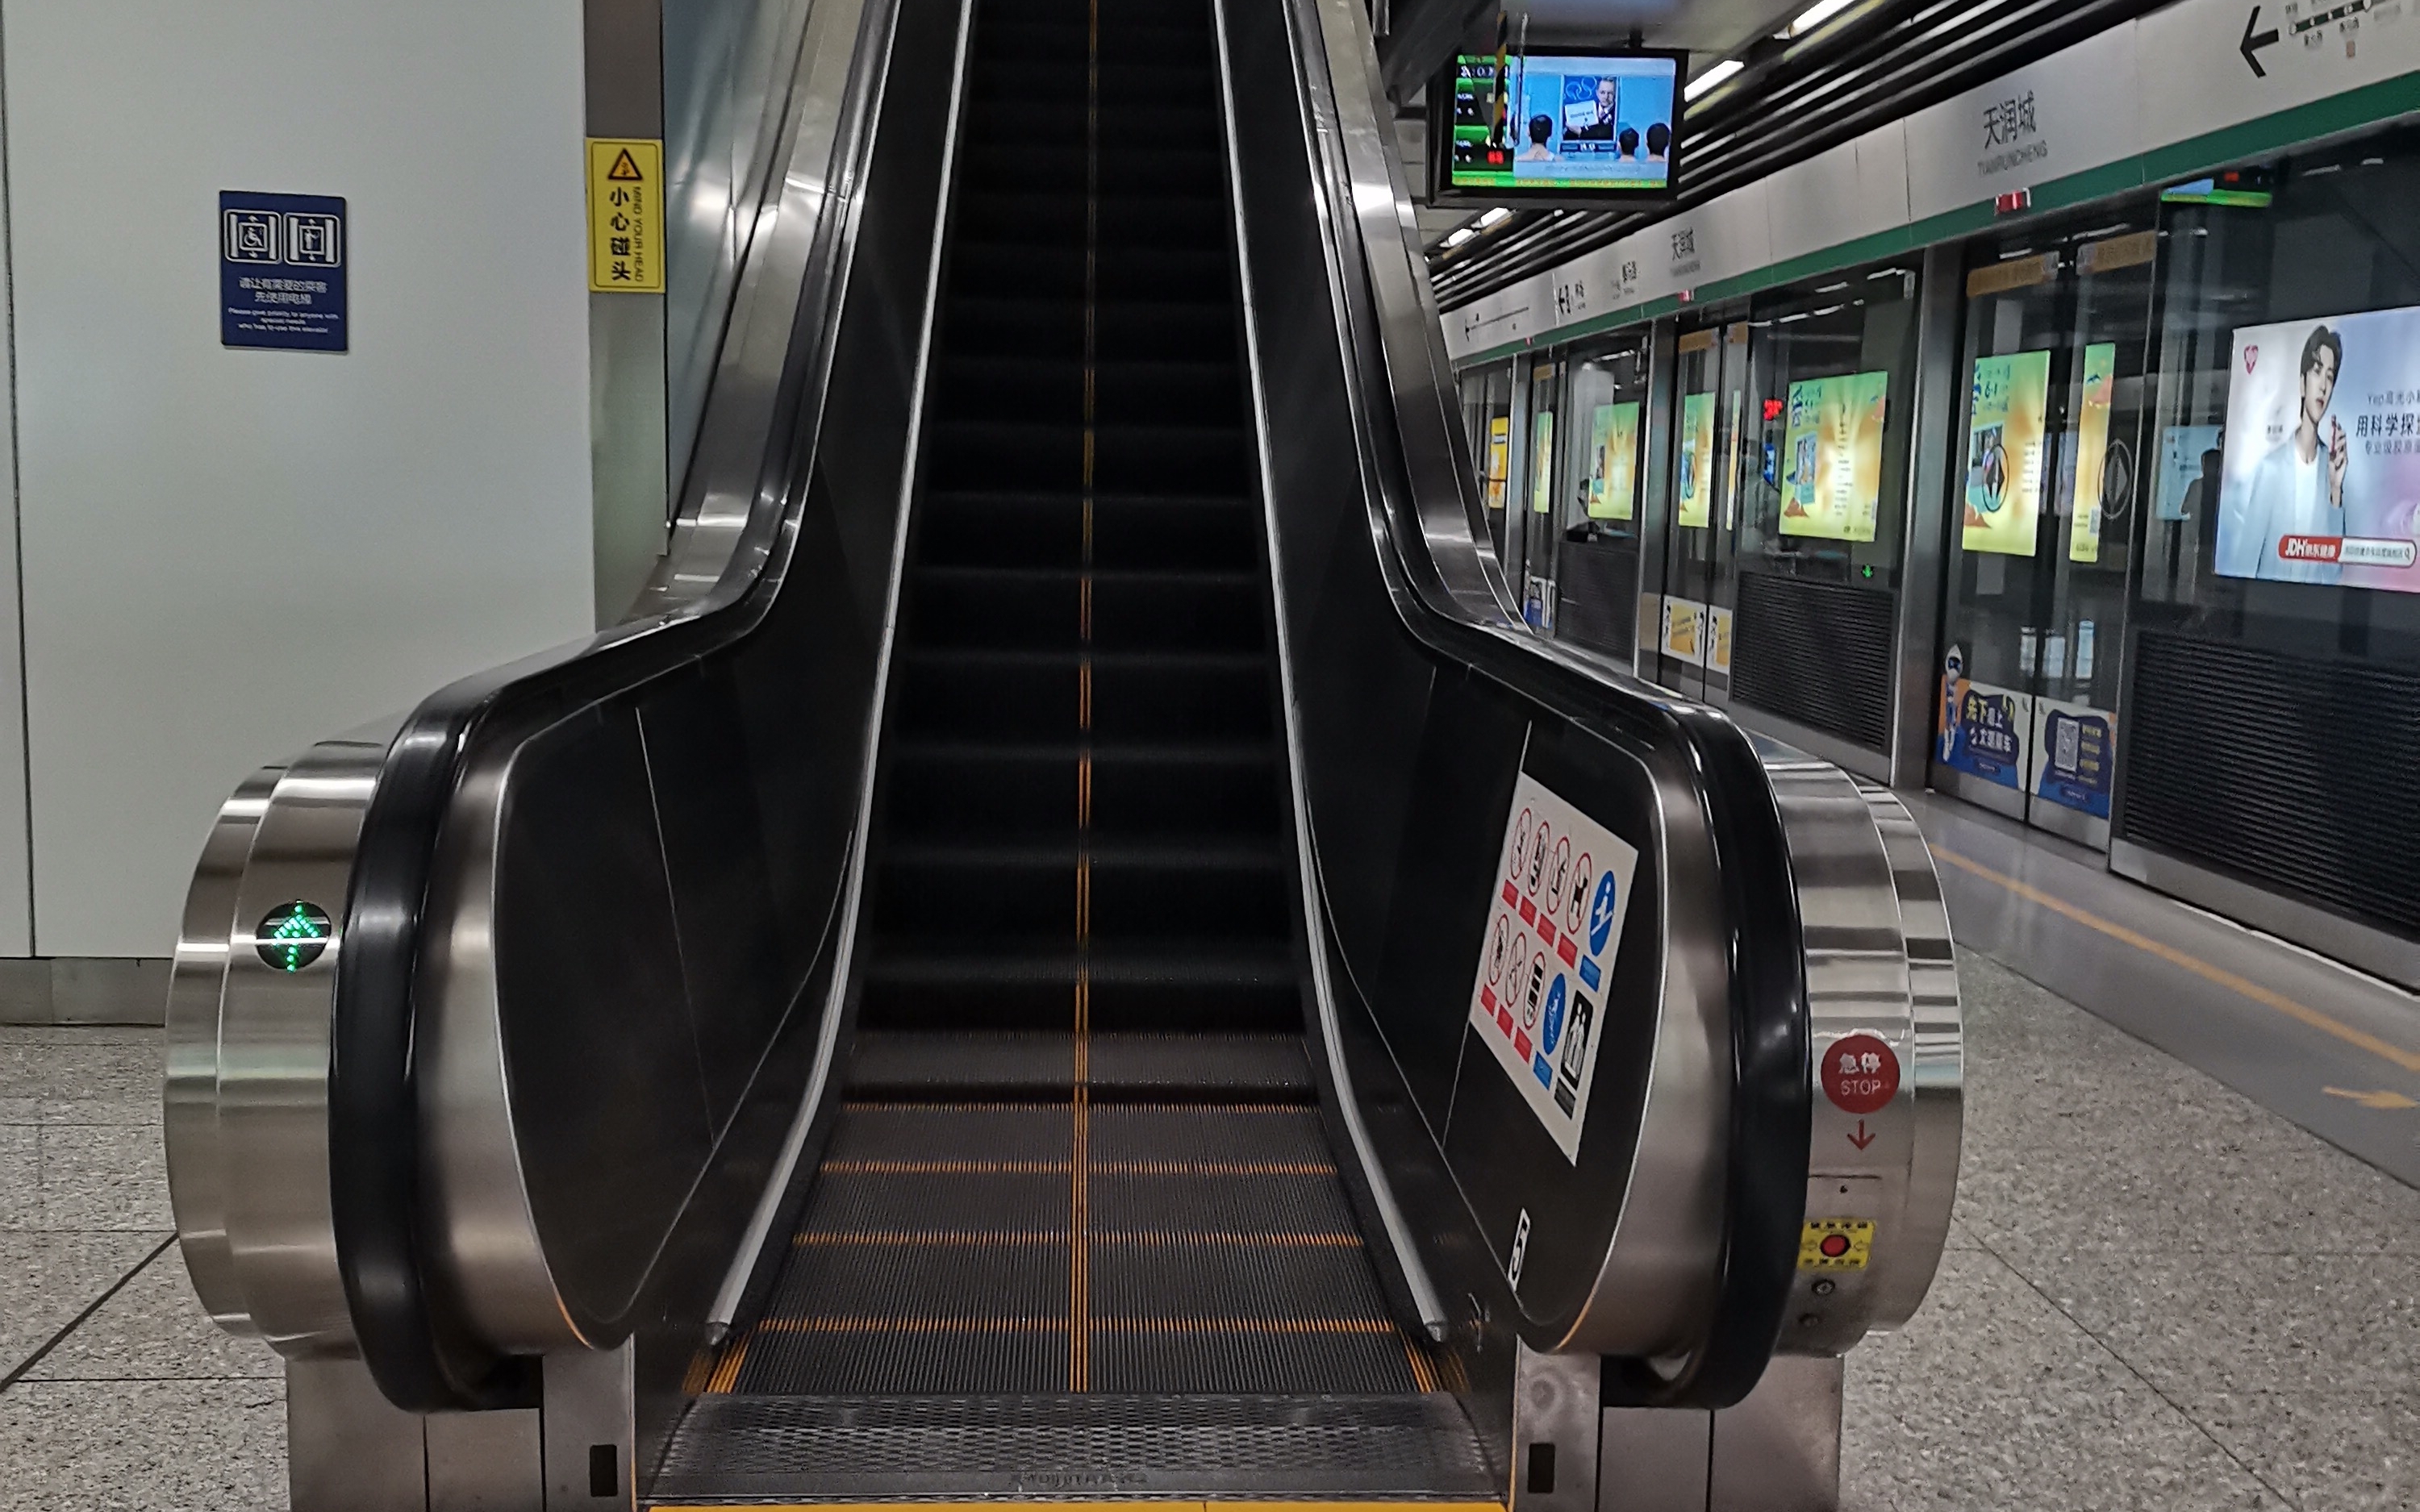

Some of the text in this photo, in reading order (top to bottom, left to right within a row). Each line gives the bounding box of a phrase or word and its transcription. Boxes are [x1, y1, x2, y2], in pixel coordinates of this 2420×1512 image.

[1983, 89, 2037, 150] 天润城
[609, 186, 632, 281] 小心碰头
[633, 218, 643, 249] YOUR
[634, 252, 644, 282] HEAD
[1838, 1052, 1882, 1074] 急停
[1840, 1079, 1881, 1097] STOP
